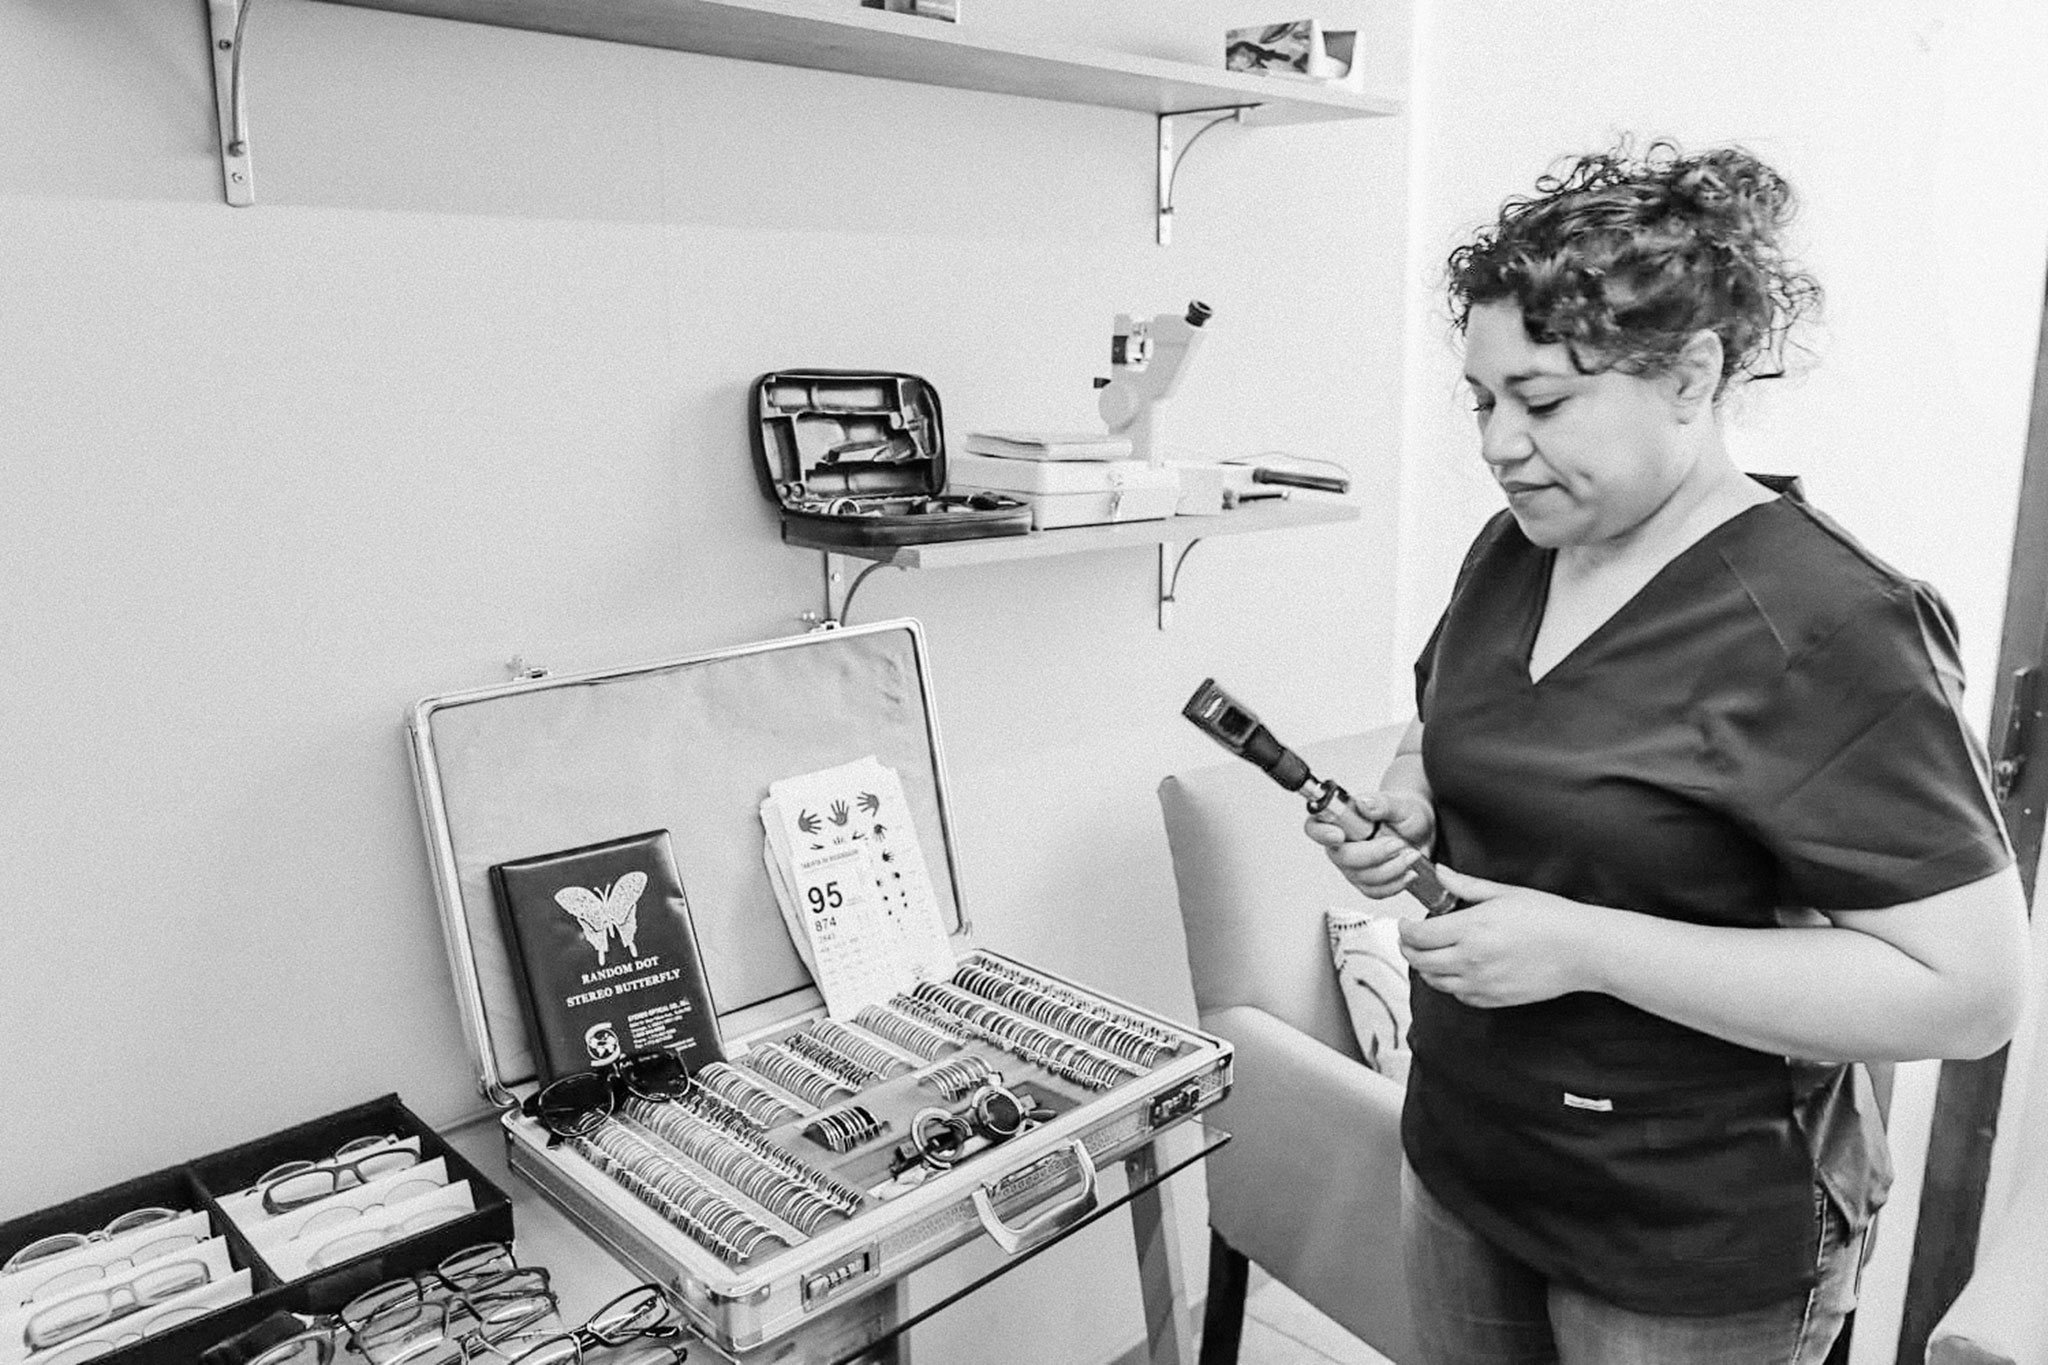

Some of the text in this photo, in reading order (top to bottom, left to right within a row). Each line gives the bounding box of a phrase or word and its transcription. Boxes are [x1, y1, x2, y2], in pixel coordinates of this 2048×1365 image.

[807, 881, 843, 914] 95
[814, 917, 837, 931] 874
[581, 955, 659, 984] RANDOM DOT
[566, 968, 681, 1007] STEREO BUTTERFLY
